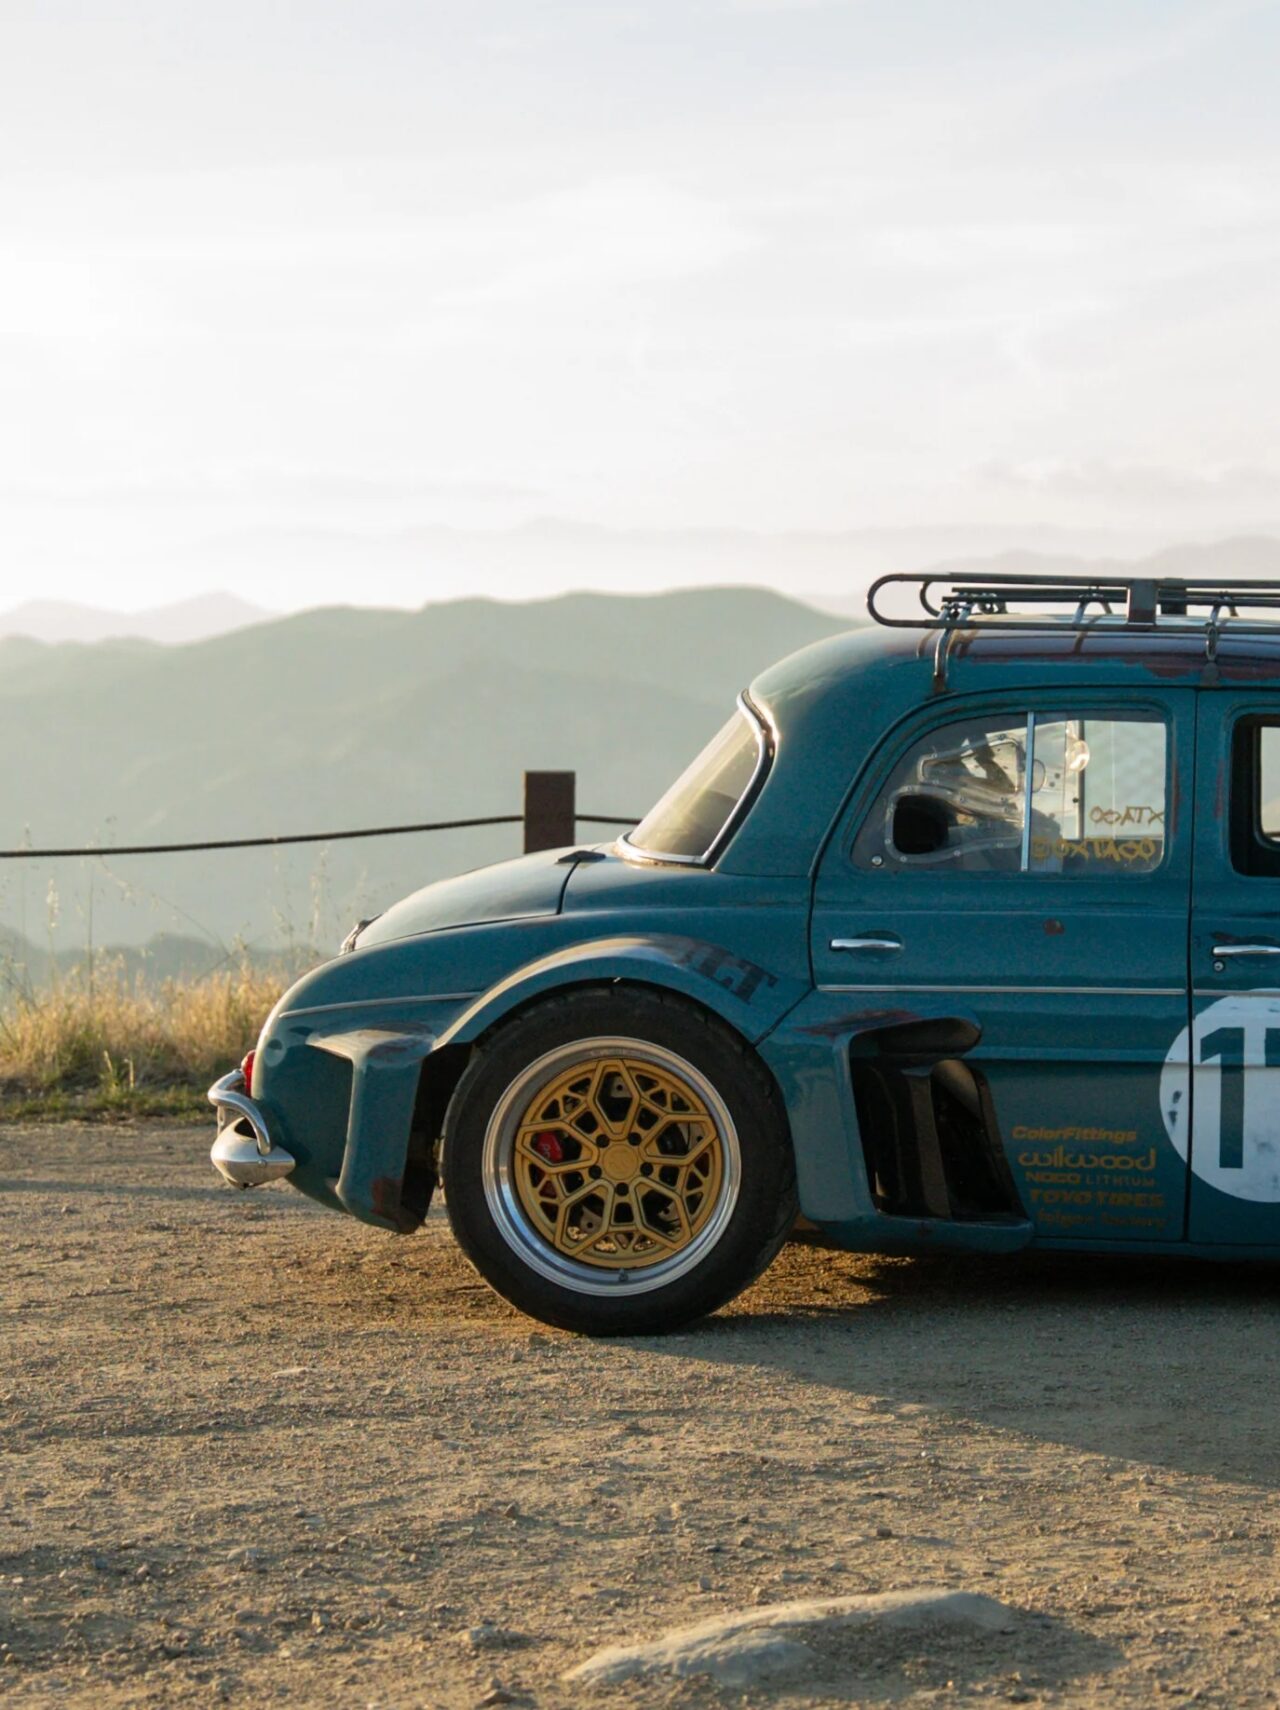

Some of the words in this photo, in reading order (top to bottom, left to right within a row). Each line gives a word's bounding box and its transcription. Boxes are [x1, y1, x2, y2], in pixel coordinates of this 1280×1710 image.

[1018, 1146, 1157, 1171] wilwood
[1086, 1175, 1155, 1187] LITHIUM
[1030, 1188, 1092, 1205] TOYO
[1096, 1190, 1165, 1208] TIRES
